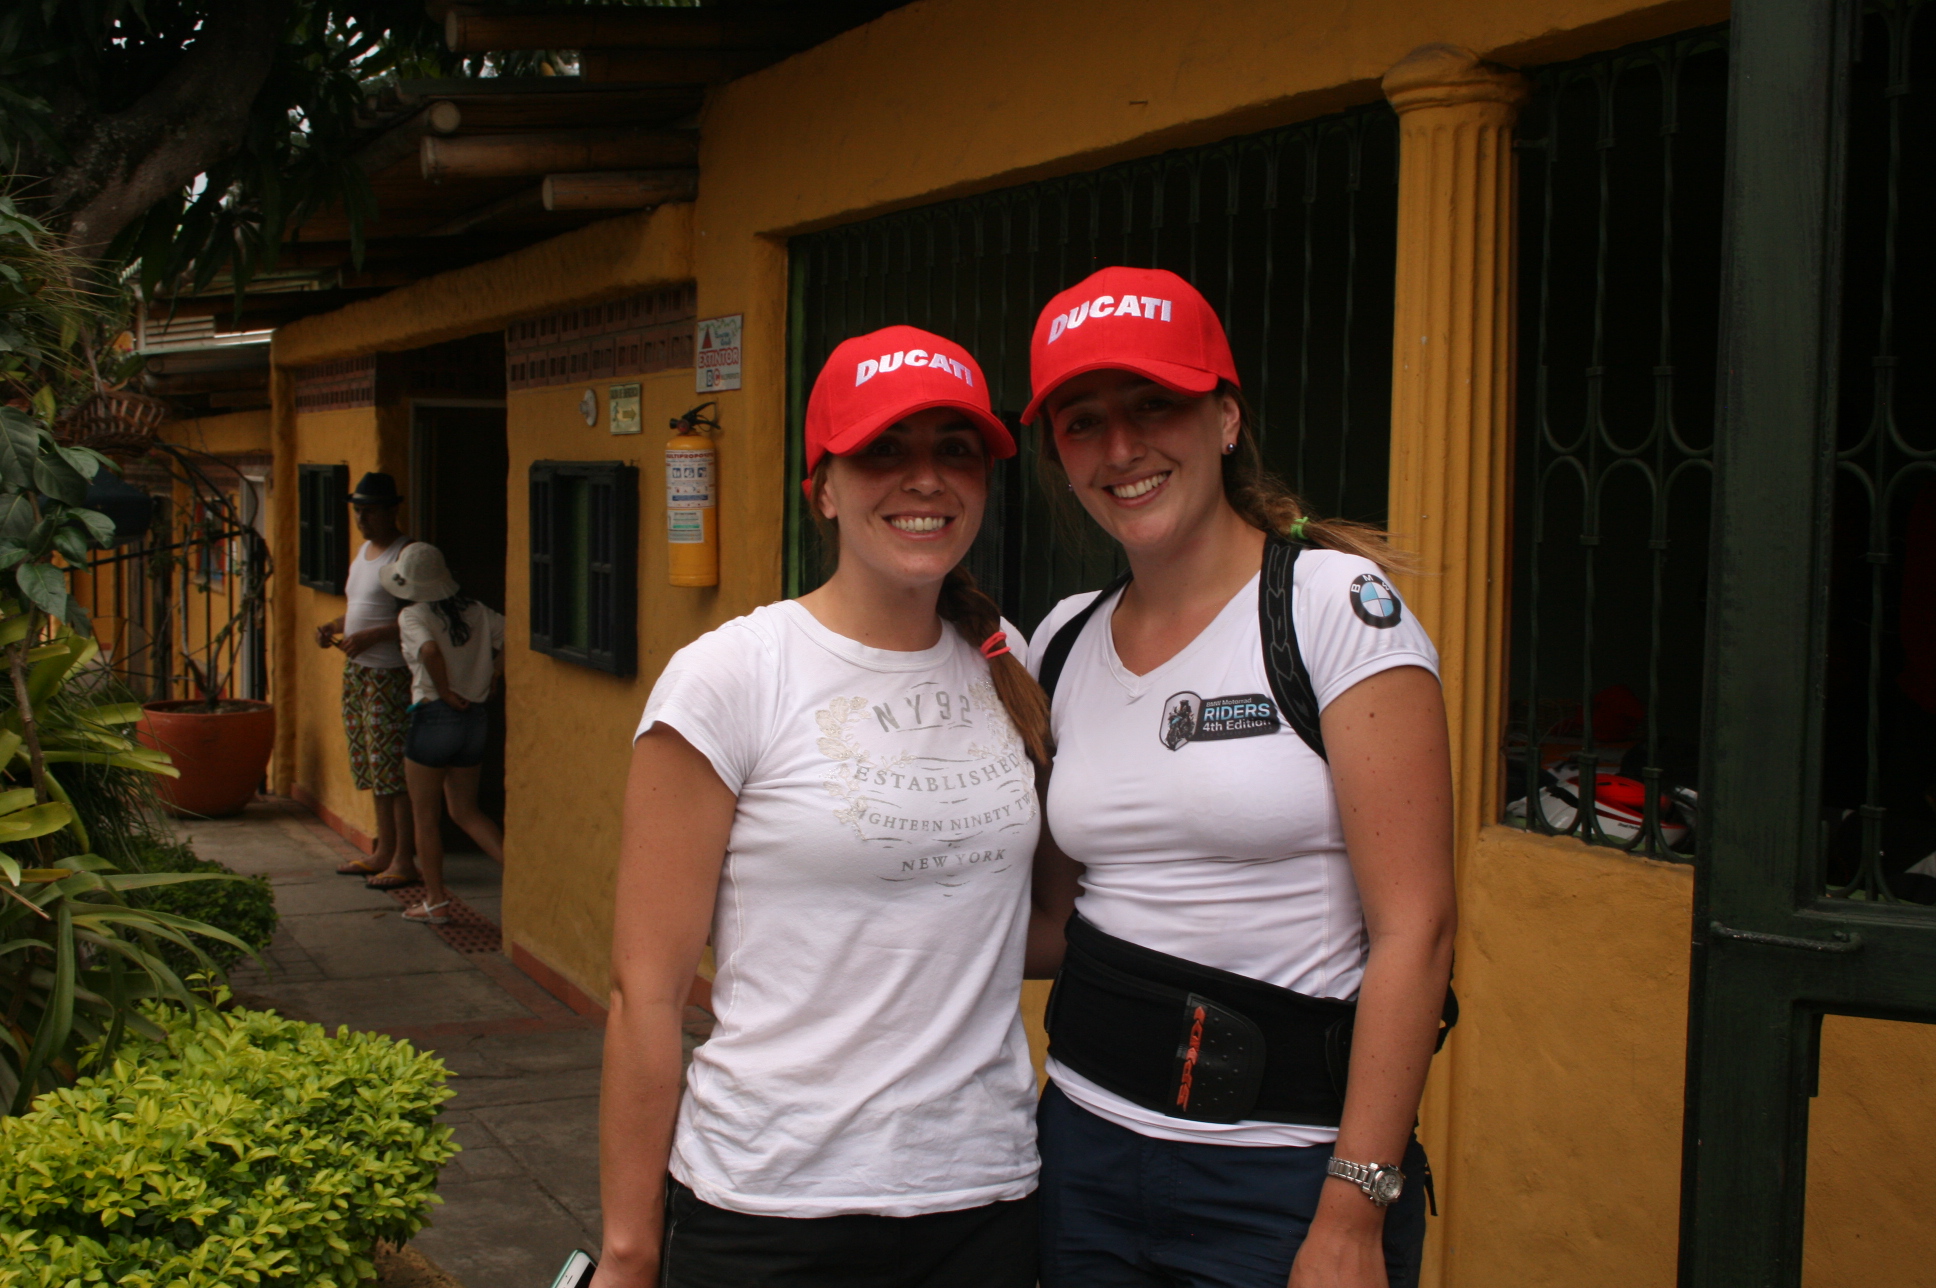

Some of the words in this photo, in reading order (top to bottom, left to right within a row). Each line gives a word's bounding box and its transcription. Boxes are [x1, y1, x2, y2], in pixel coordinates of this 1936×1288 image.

[1047, 295, 1173, 346] DUCATI
[698, 346, 740, 369] EXTINTOR
[855, 348, 974, 388] DUCATI
[1350, 574, 1390, 593] BMW
[872, 690, 973, 733] NY92
[1203, 702, 1271, 722] RIDERS
[1222, 697, 1252, 706] Motorrad
[1202, 721, 1223, 732] 4th
[1226, 718, 1271, 731] Edition
[855, 752, 1020, 792] ESTABLISHED
[857, 809, 943, 832] IGHTEEN
[950, 804, 1011, 831] NINETY
[1015, 791, 1035, 811] TW
[901, 855, 948, 872] NEW
[955, 848, 1007, 865] YORK
